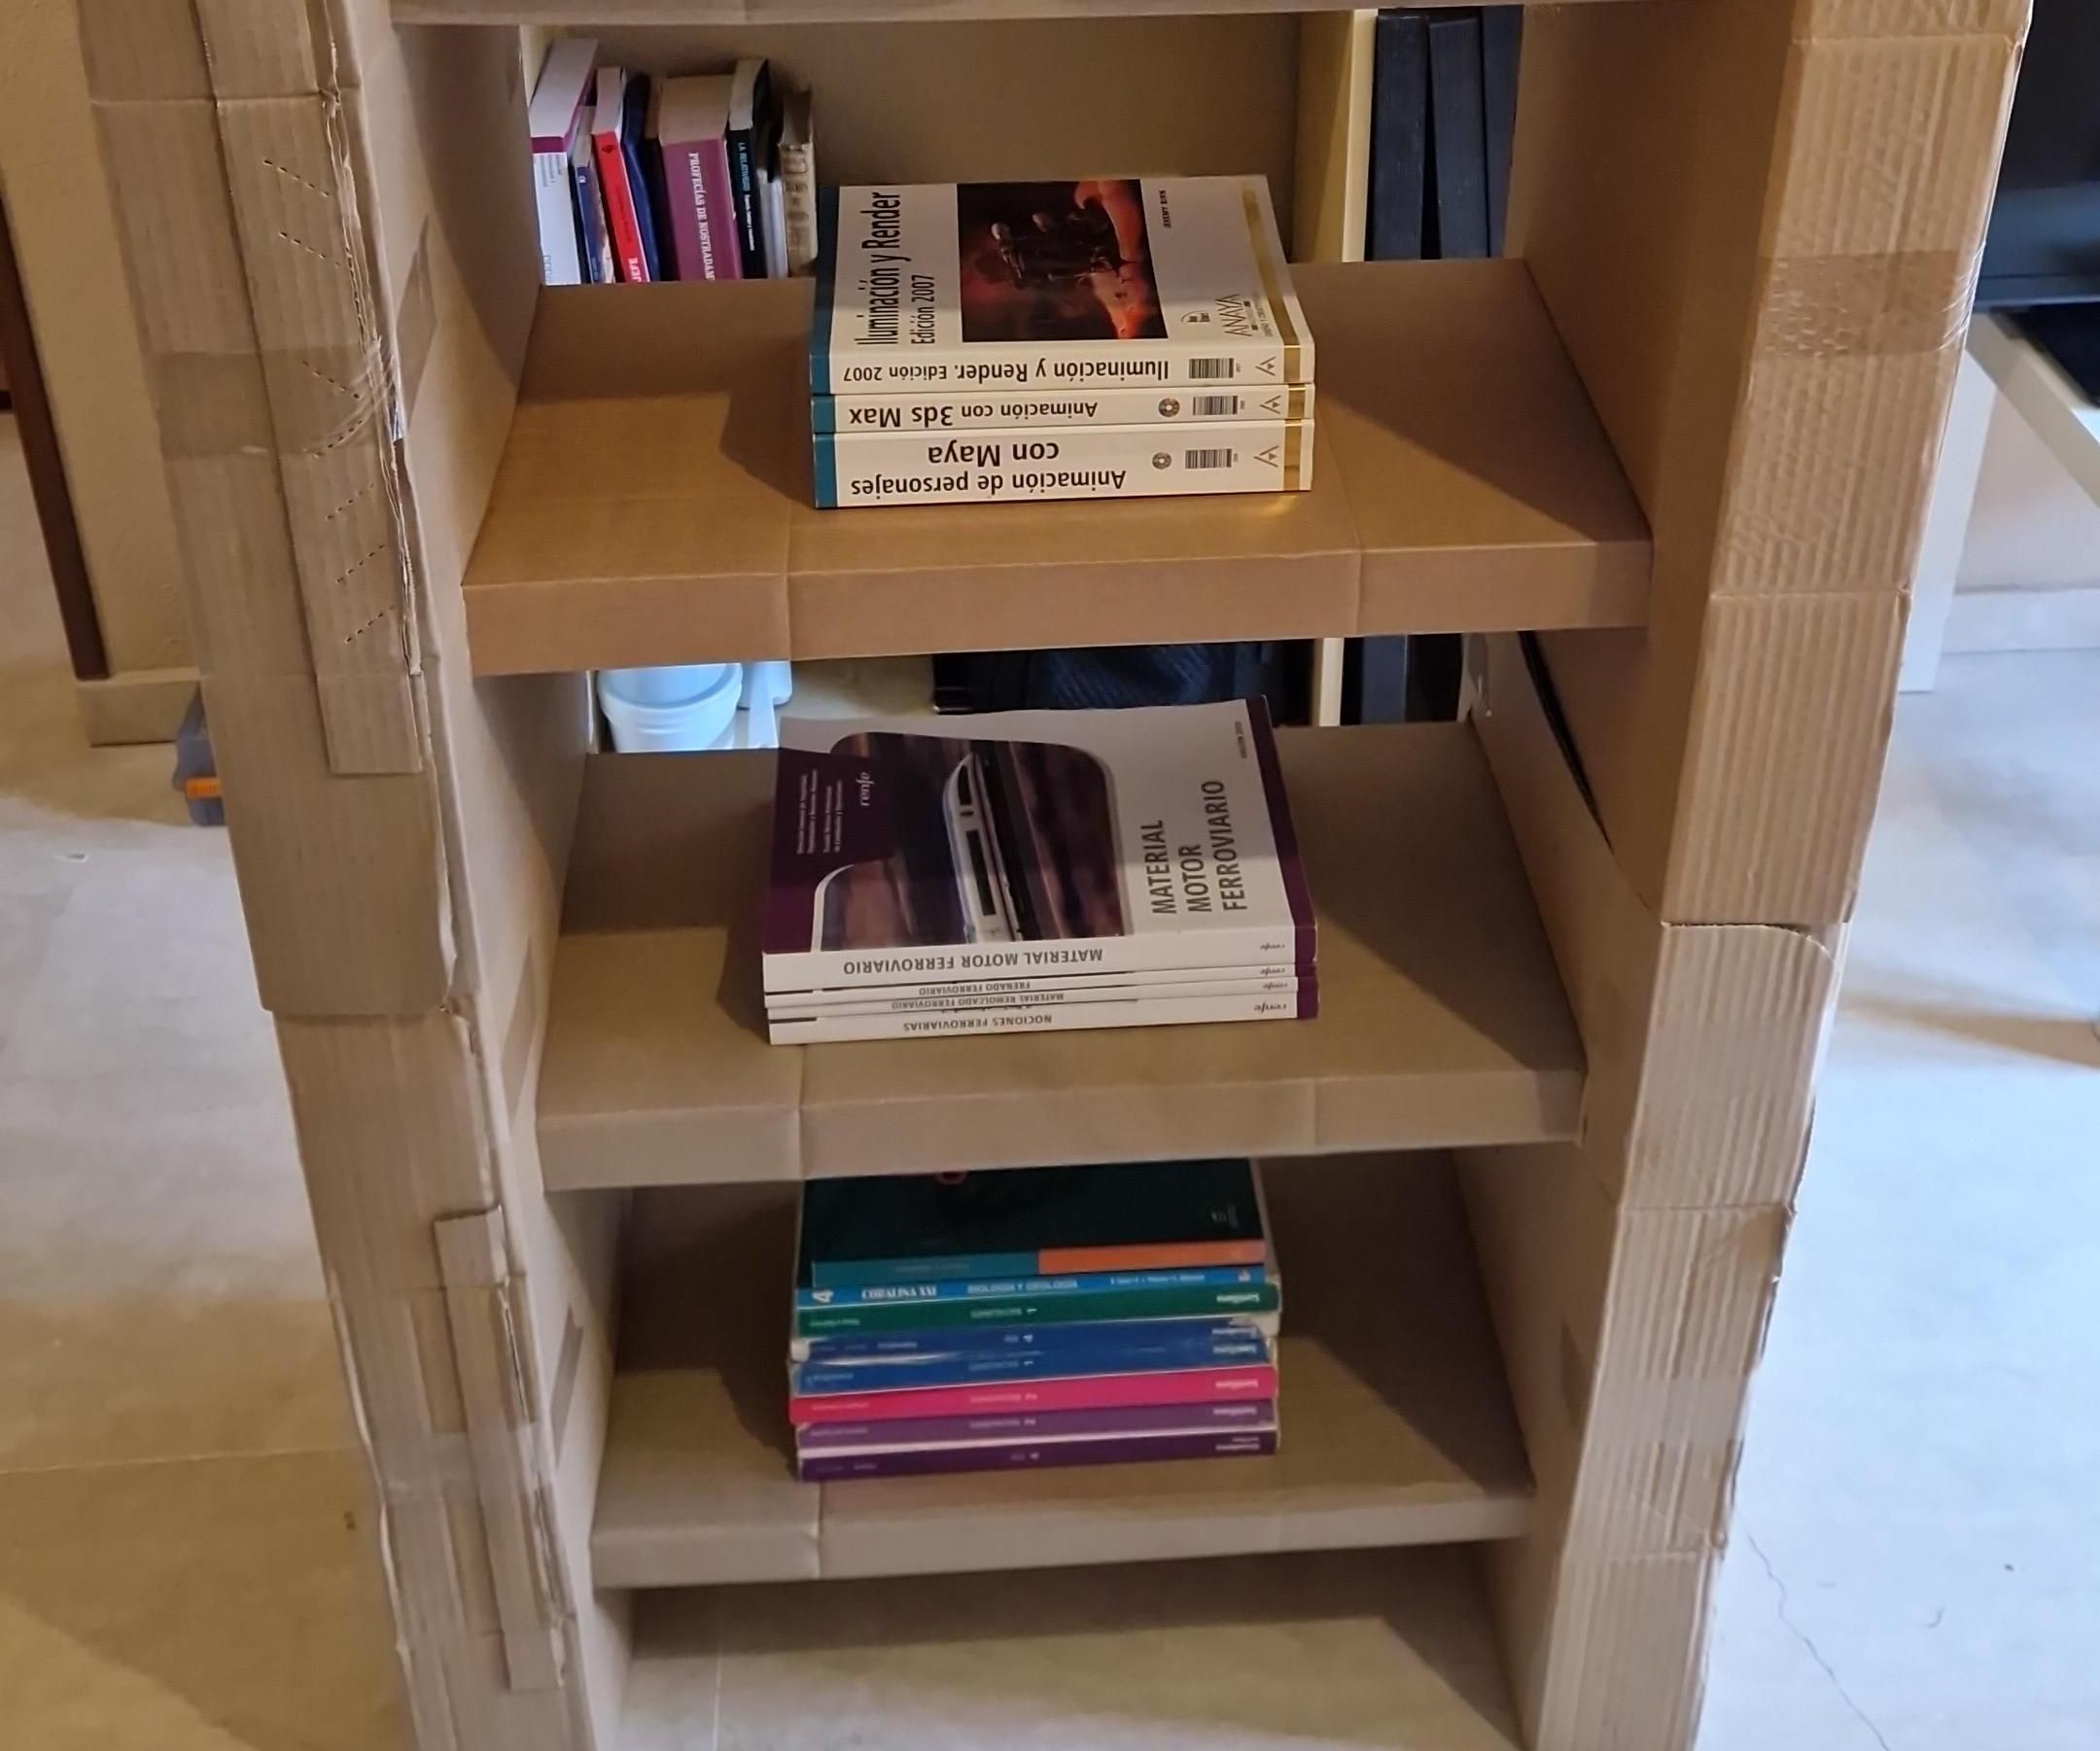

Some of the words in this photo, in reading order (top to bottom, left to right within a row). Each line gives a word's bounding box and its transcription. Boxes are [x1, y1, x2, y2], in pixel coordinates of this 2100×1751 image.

[696, 206, 708, 220] DE
[859, 192, 900, 249] Render
[699, 222, 716, 281] NOSTRADAM
[870, 254, 912, 263] y
[911, 274, 935, 302] 2007
[854, 267, 900, 345] Iluminación
[1215, 294, 1252, 336] ANAYA
[910, 306, 935, 344] Edición
[843, 367, 883, 382] 2007
[889, 366, 947, 381] Edición
[954, 363, 1028, 385] Render.
[1035, 358, 1046, 378] y
[1054, 360, 1169, 382] Iluminación
[849, 406, 901, 428] Max
[911, 405, 954, 428] 3ds
[962, 404, 994, 417] con
[1000, 402, 1098, 420] Animación
[928, 439, 1000, 468] Maya
[1013, 442, 1059, 461] con
[852, 471, 968, 500] personajes
[978, 473, 1003, 495] de
[1012, 470, 1127, 493] Animación
[856, 771, 875, 807] renfe
[1201, 781, 1248, 911] FERROVIARIO
[1140, 820, 1176, 914] MATERIAL
[1178, 844, 1212, 913] MOTOR
[844, 956, 954, 974] FERROVIARIO
[962, 953, 1018, 968] MOTOR
[1024, 949, 1102, 964] MATERIAL
[919, 983, 983, 996] FERROVIARIO
[986, 981, 1031, 993] FRENADO
[1020, 993, 1065, 1002] MATERIAL
[892, 998, 955, 1010] FERROVIARIO
[903, 1018, 988, 1032] FERROVIARIAS
[992, 1014, 1052, 1027] NOCIONES
